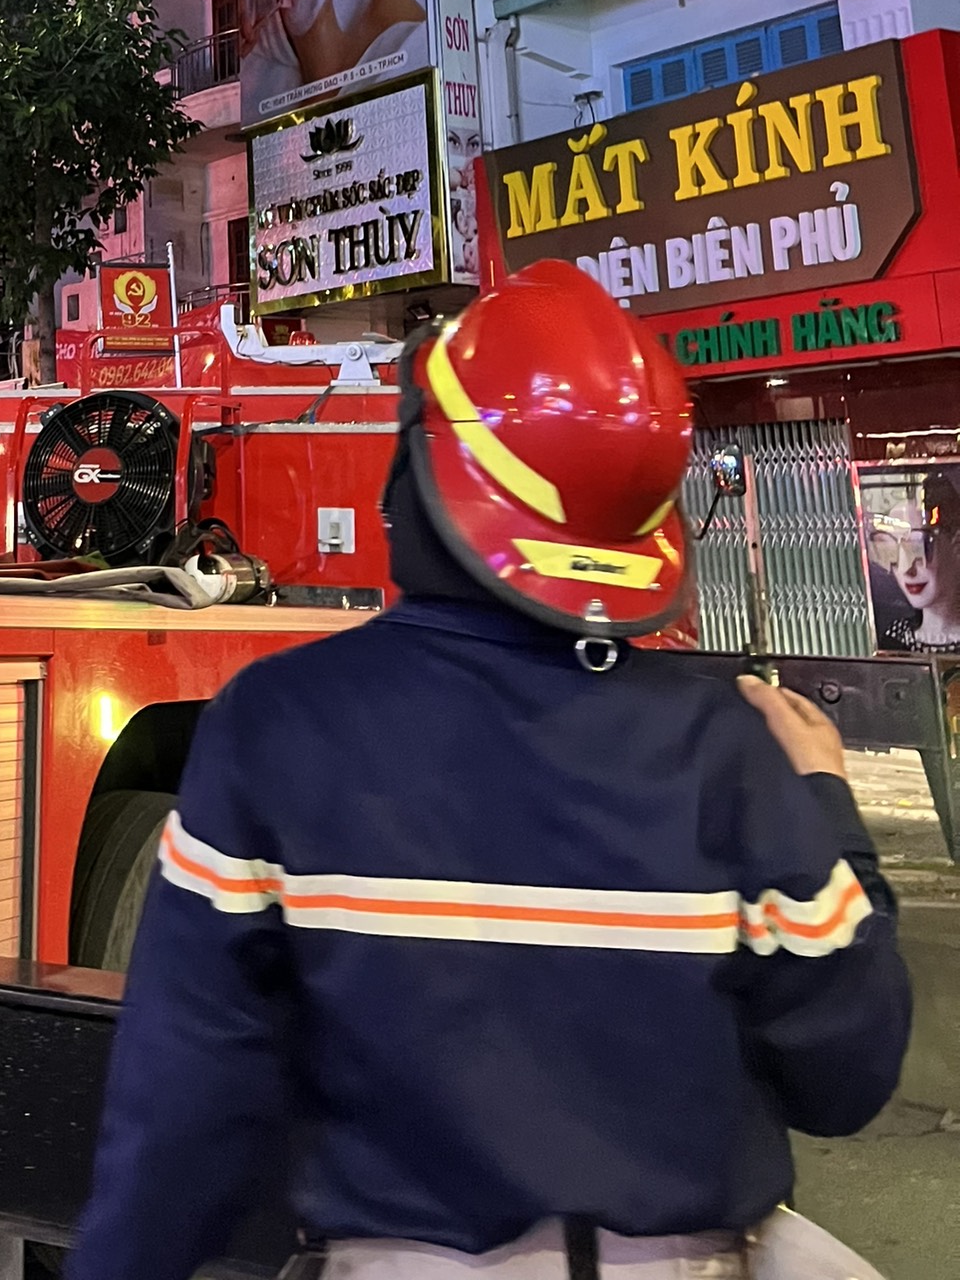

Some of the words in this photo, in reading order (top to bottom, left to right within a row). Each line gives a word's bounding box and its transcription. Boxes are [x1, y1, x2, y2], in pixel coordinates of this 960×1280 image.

[502, 123, 650, 239] MẮT
[669, 75, 891, 201] KÍNH
[328, 206, 424, 275] THÙY
[665, 216, 764, 289] BIÊN
[770, 181, 861, 272] PHỦ
[56, 343, 76, 360] HO
[122, 313, 151, 328] 92
[675, 312, 780, 366] CHÍNH
[791, 298, 899, 352] HÃNG
